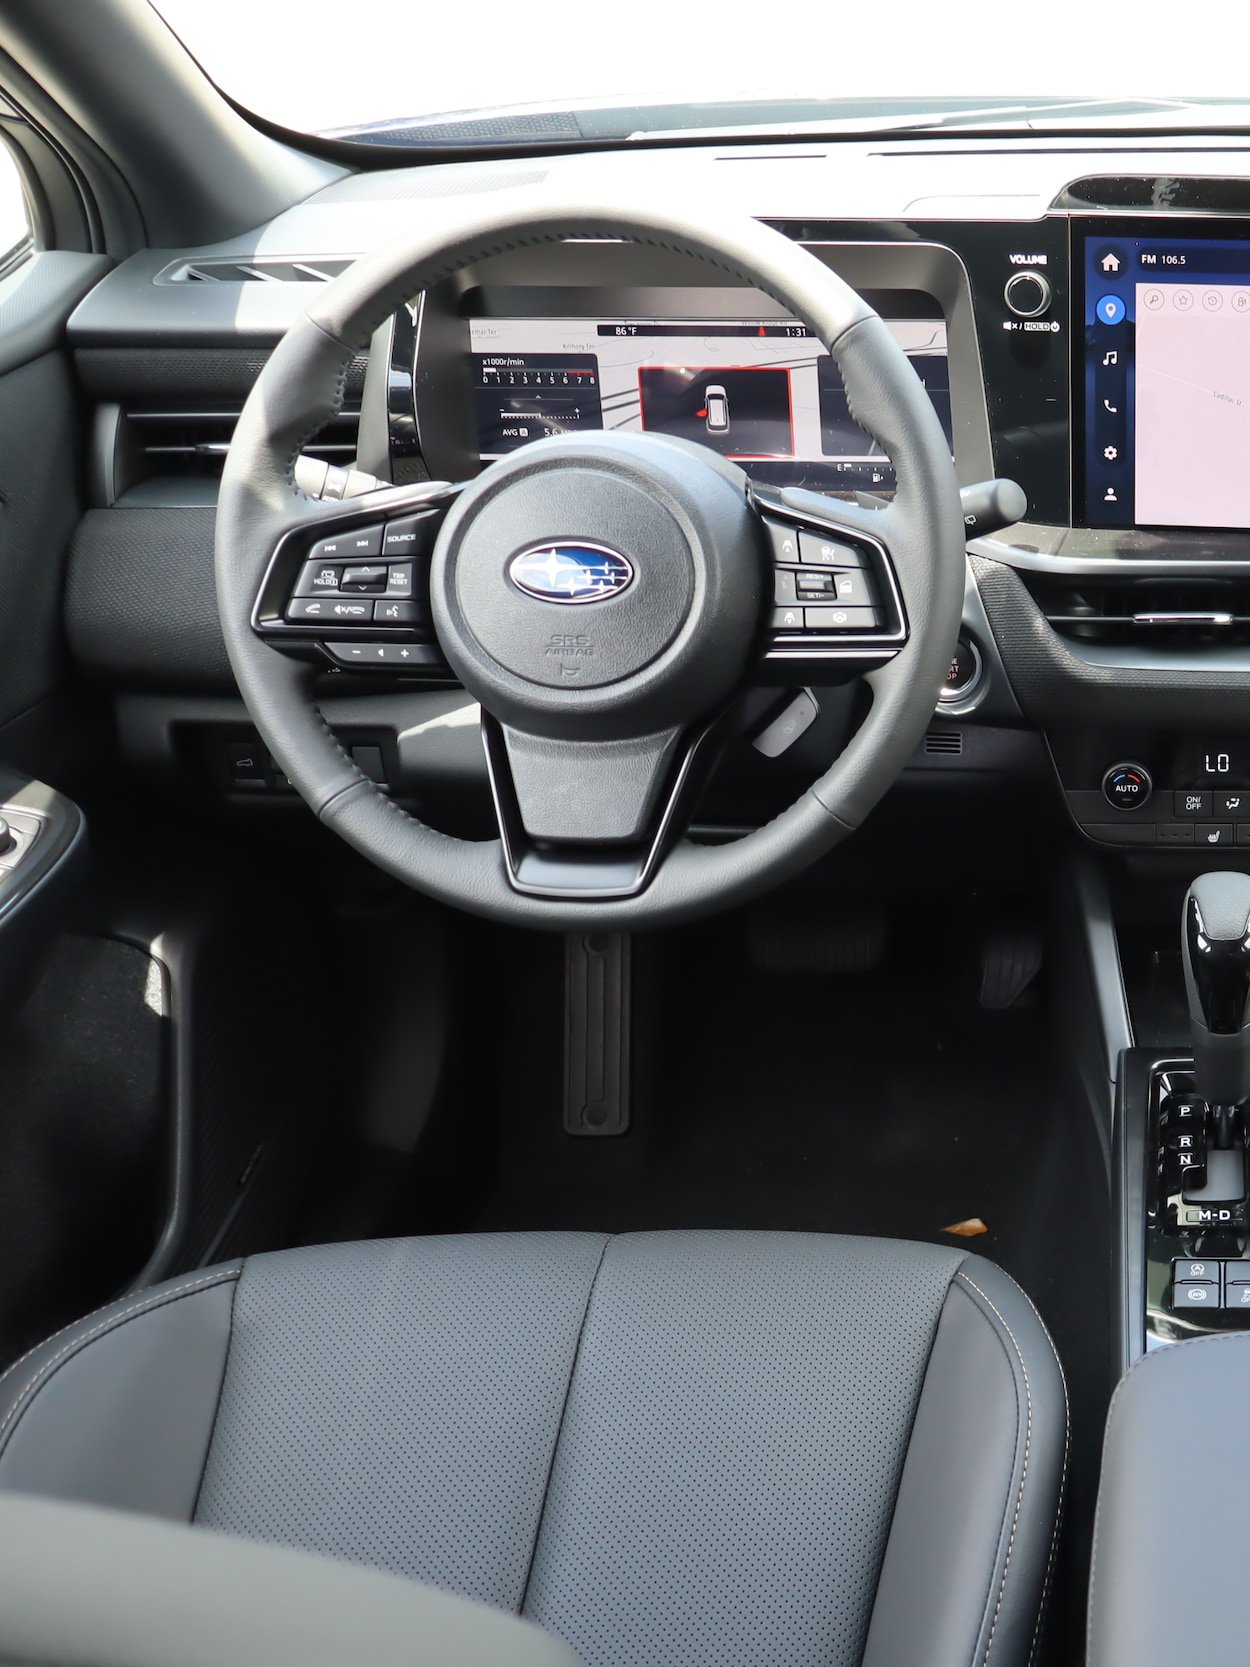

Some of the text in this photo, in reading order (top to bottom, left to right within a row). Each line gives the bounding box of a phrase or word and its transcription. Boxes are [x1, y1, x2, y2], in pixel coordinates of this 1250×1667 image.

[1009, 254, 1047, 264] VOLUME
[1141, 254, 1186, 264] FM 106.5
[615, 326, 627, 335] 86
[1024, 322, 1050, 331] HOLD
[785, 327, 806, 337] 1:31
[482, 357, 525, 367] x1000r/min
[483, 376, 489, 384] 0
[509, 376, 515, 384] 2
[523, 376, 528, 384] 3
[536, 376, 541, 384] 4
[550, 376, 555, 384] 5
[563, 376, 568, 384] 6
[576, 376, 582, 384] 7
[589, 376, 595, 384] 8
[502, 428, 518, 437] AVG
[387, 533, 417, 543] SOURCE
[550, 634, 591, 647] SRS
[545, 647, 595, 656] AIRBAG
[1205, 753, 1230, 773] LO
[1115, 784, 1139, 793] AUTO
[1186, 795, 1202, 804] ON/
[1185, 803, 1202, 811] OFF
[1180, 1107, 1191, 1115] P
[1180, 1137, 1192, 1147] R
[1180, 1155, 1192, 1165] N
